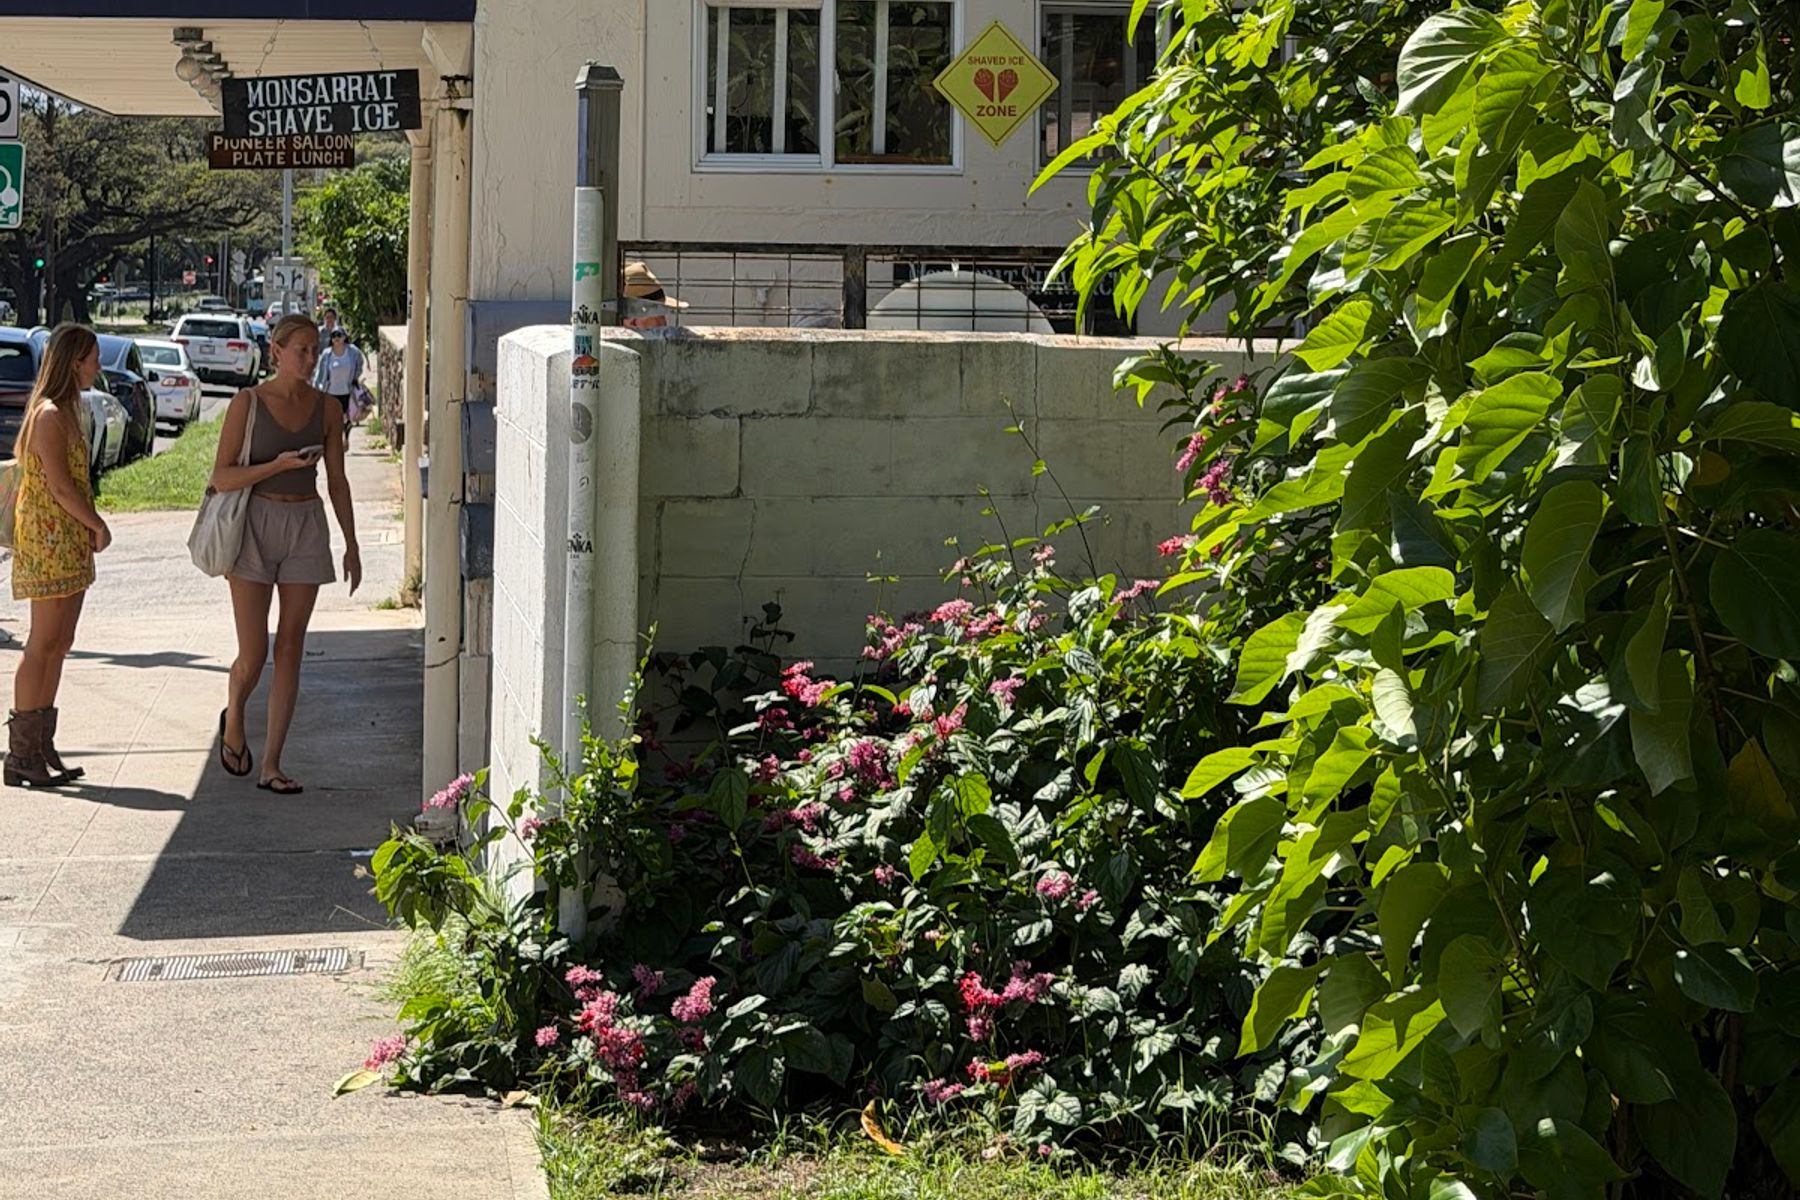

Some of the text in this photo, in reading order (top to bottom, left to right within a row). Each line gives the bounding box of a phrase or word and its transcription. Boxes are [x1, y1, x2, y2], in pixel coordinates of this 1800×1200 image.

[967, 55, 1025, 66] SHAVED ICE
[247, 73, 397, 109] MONSARRAT
[976, 105, 1017, 117] ZONE
[248, 102, 400, 137] SHAVE ICE
[292, 135, 354, 150] SALOON
[233, 151, 345, 166] PLATE LUNCH
